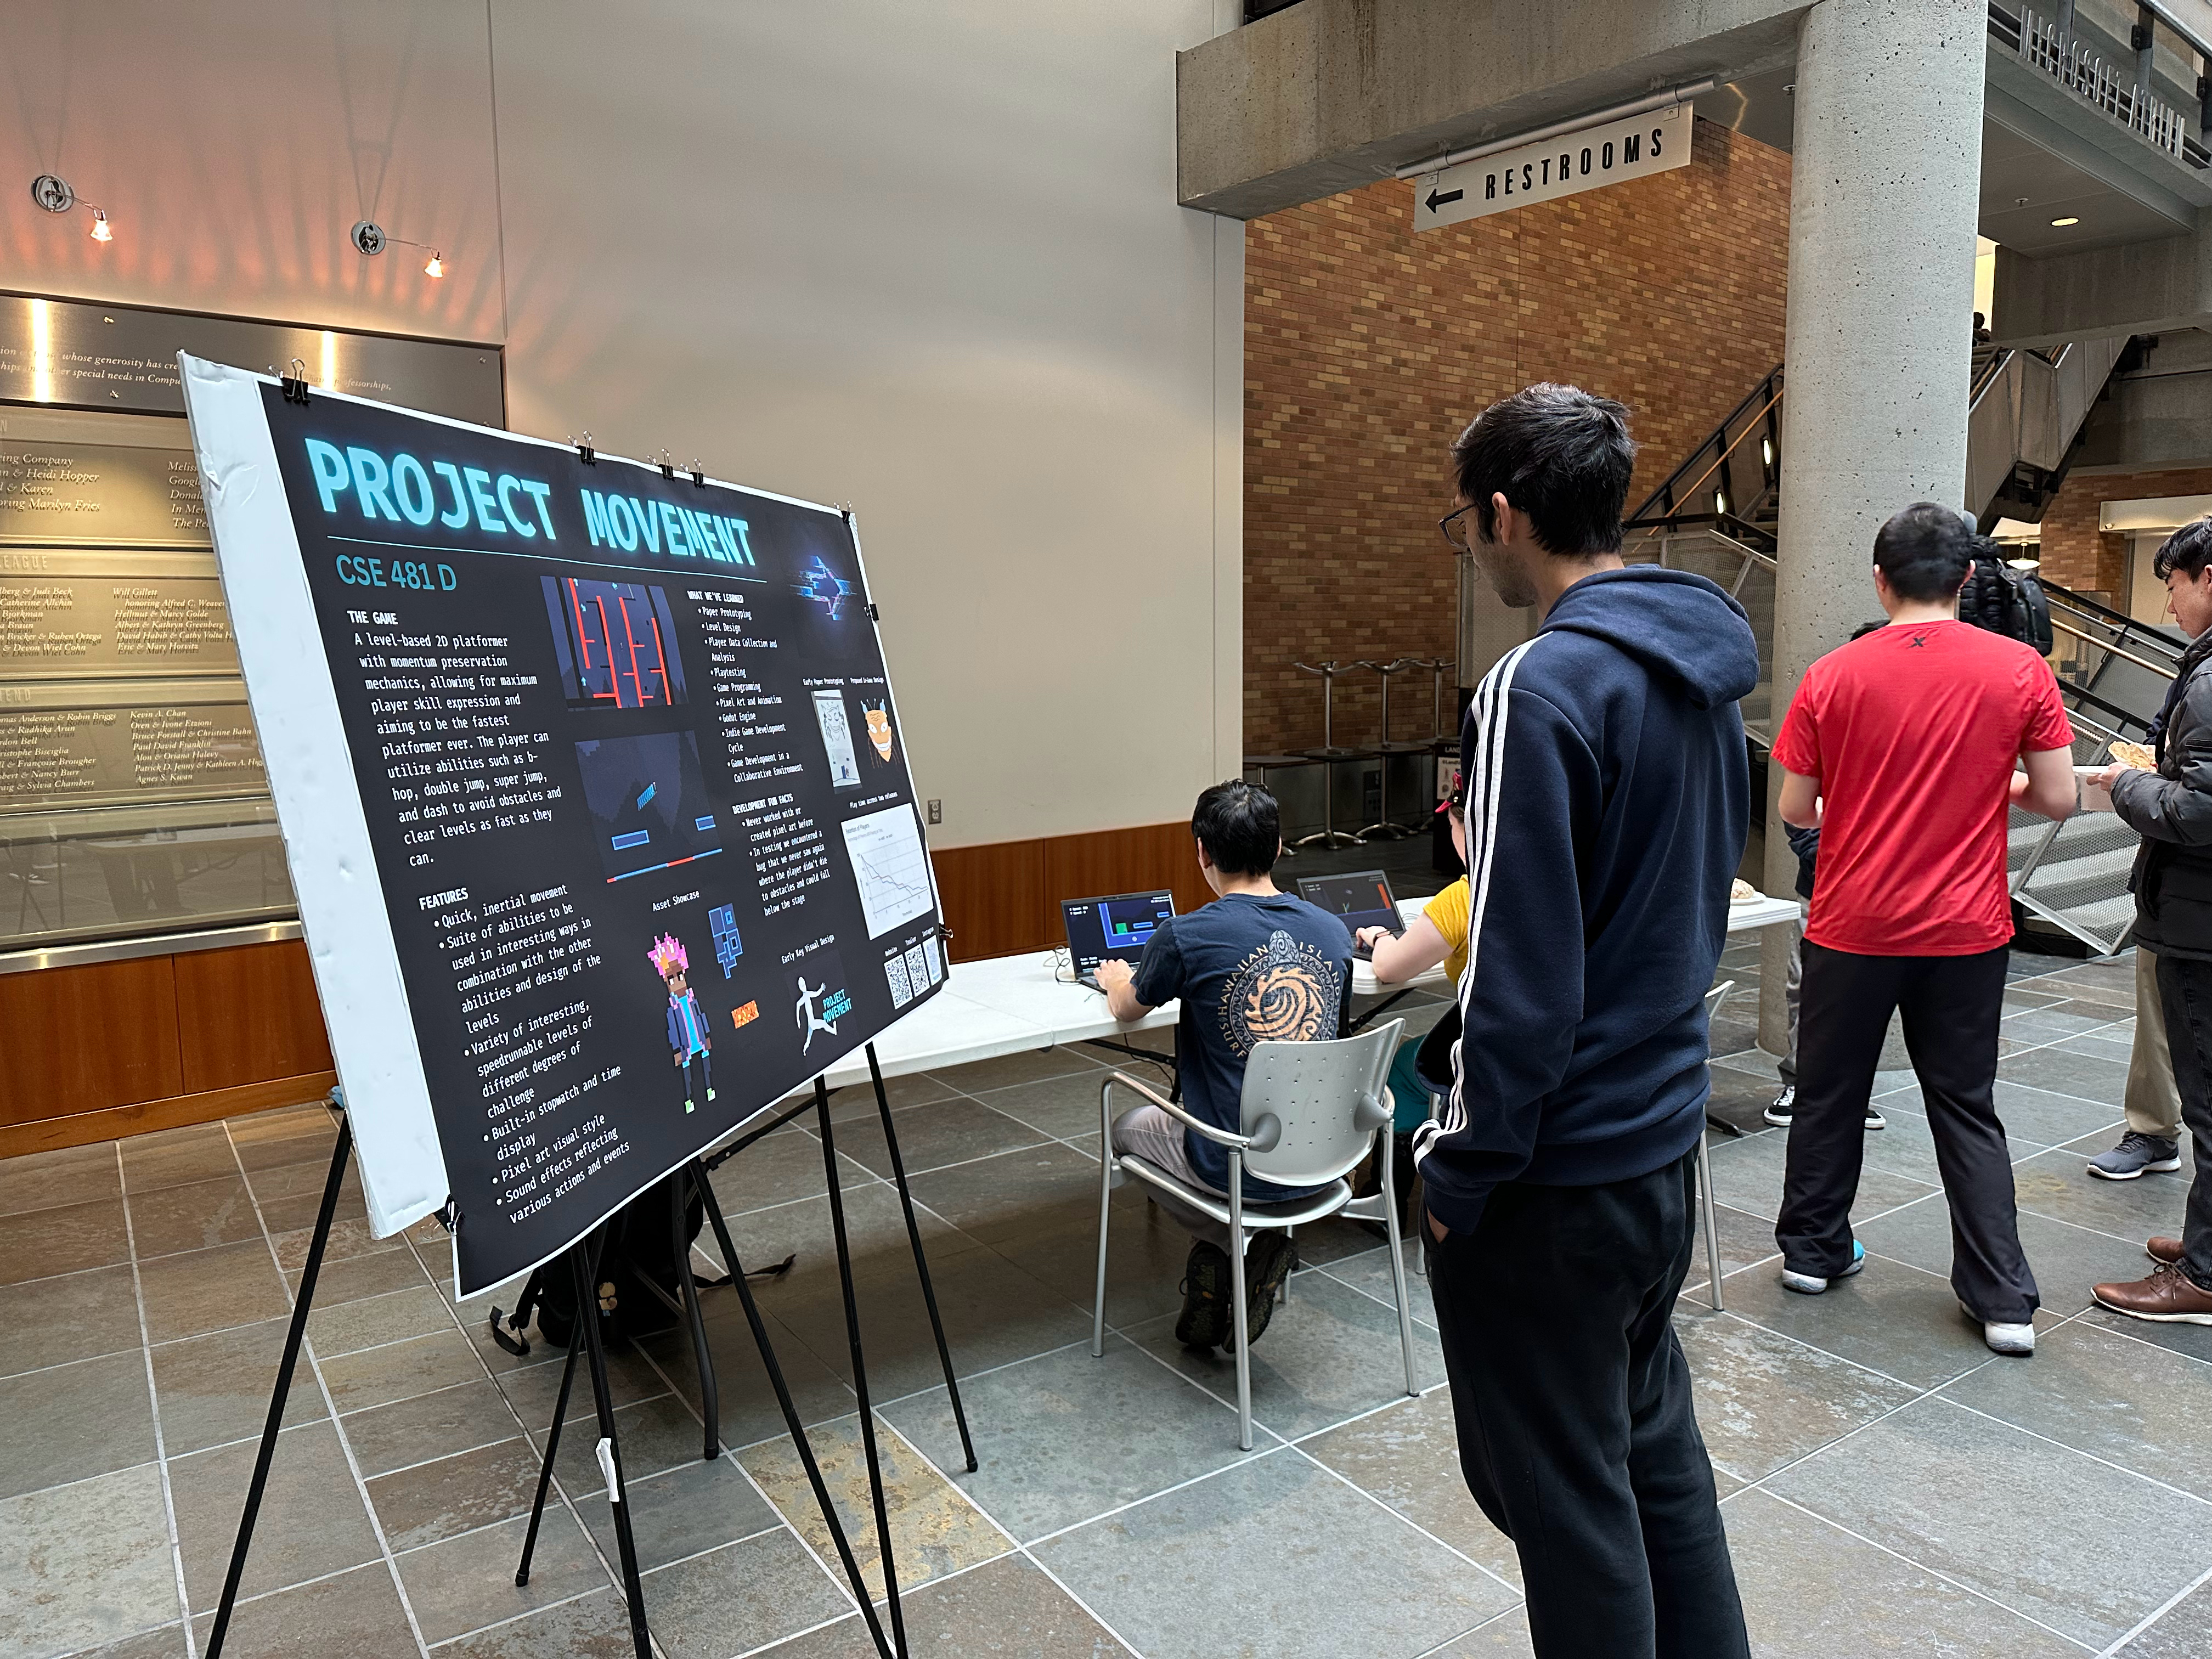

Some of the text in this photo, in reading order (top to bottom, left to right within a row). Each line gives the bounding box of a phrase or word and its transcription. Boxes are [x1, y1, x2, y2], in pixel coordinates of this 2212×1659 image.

[1486, 128, 1662, 200] RESTROOMS
[62, 352, 162, 369] whose generosity has
[72, 368, 105, 379] special
[108, 371, 132, 381] needs
[136, 372, 145, 381] in
[22, 454, 73, 467] Company
[27, 469, 57, 478] Heidi
[60, 470, 99, 482] Hopper
[21, 483, 53, 493] Karen
[29, 498, 100, 512] Marilyn Fries
[304, 438, 757, 566] PROJECT MOVEMENT
[335, 554, 457, 591] CSE 481 D
[32, 587, 50, 596] Judi
[53, 587, 73, 596] Beck
[113, 588, 130, 596] Will
[687, 590, 703, 600] WHAT
[704, 591, 722, 602] WE'VE
[347, 611, 399, 625] THE GAME
[702, 606, 752, 621] Paper Prototyping
[76, 632, 101, 641] Ortega
[706, 622, 741, 634] Level Design
[146, 643, 166, 651] Mary
[355, 633, 508, 650] A level-based 2D platformer
[708, 636, 727, 649] Player
[729, 638, 741, 647] Data
[742, 638, 769, 648] Collection
[359, 654, 508, 670] with momentum preservation
[712, 652, 735, 664] Analysis
[714, 667, 747, 679] Playtesting
[365, 674, 538, 691] mechanics, allowing for maximum
[371, 693, 521, 715] player skill expression and
[93, 712, 116, 721] Briggs
[723, 711, 757, 723] Godot Engine
[154, 741, 176, 749] David
[179, 740, 211, 749] Franklin
[732, 793, 794, 815] DEVELOPMENT FUN FACTS
[746, 817, 761, 827] Never
[763, 810, 781, 823] worked
[782, 808, 794, 819] with
[751, 819, 814, 842] created pixel art before
[419, 888, 469, 911] FEATURES
[442, 884, 568, 929] Quick, inertial movement
[653, 891, 700, 912] Asset Showcase
[764, 895, 805, 916] below the stage
[447, 903, 574, 949] Suite of abilities to be
[781, 934, 835, 964] Early Key Visual Design
[1218, 944, 1268, 1015] HAWAIIAN
[823, 989, 845, 1009] PROJECT
[823, 998, 851, 1023] MOVEMENT
[501, 1115, 605, 1182] Pixel art visual style
[506, 1128, 618, 1203] Sound effects reflecting
[510, 1142, 630, 1223] various actions and events
